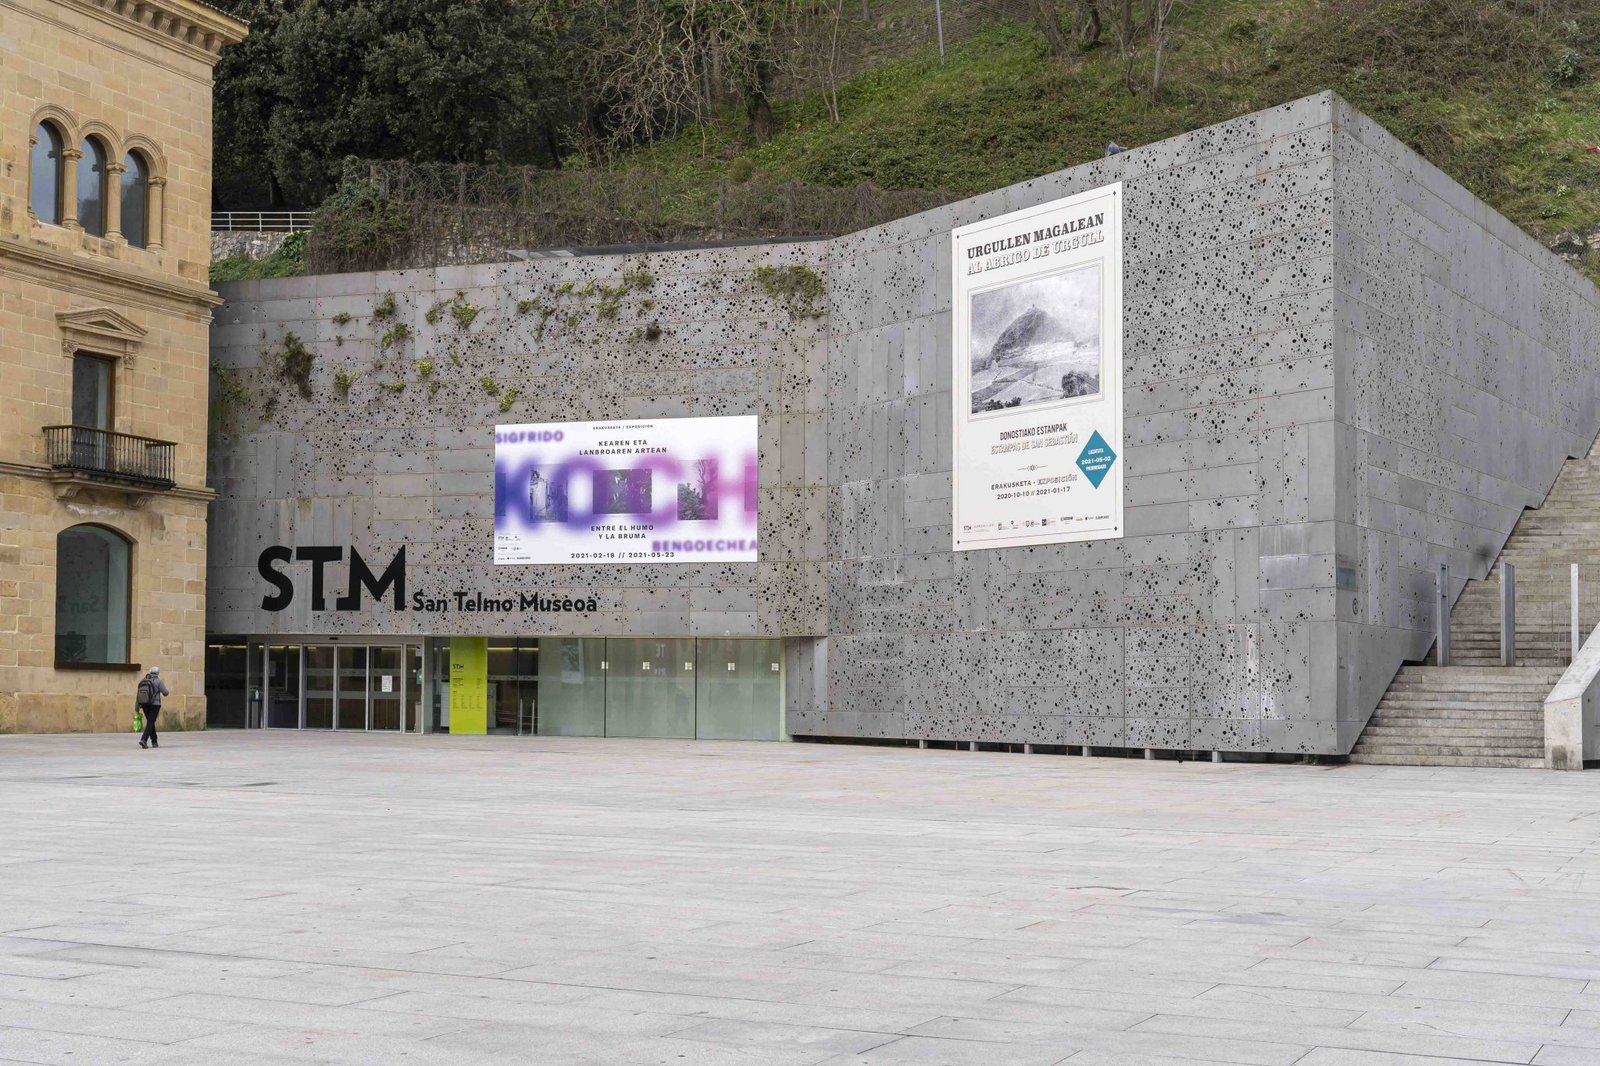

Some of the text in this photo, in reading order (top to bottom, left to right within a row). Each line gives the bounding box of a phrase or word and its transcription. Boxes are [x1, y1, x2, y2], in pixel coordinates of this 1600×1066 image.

[967, 212, 1104, 258] URGULLEN MAGALEAN
[967, 230, 1104, 275] AL ABRIGO DE URGULL
[495, 430, 564, 444] SIGFRIDO
[1000, 423, 1067, 440] DONOSTIAKO ESTANPAK
[1081, 456, 1111, 465] 2021-05-02
[991, 480, 1032, 490] ERAKUSKETA
[997, 491, 1030, 500] 2020-10-10
[1036, 486, 1070, 495] 2021-01-17
[652, 539, 757, 552] BENGOECHEA
[258, 544, 597, 612] STM San Telmo Museoa
